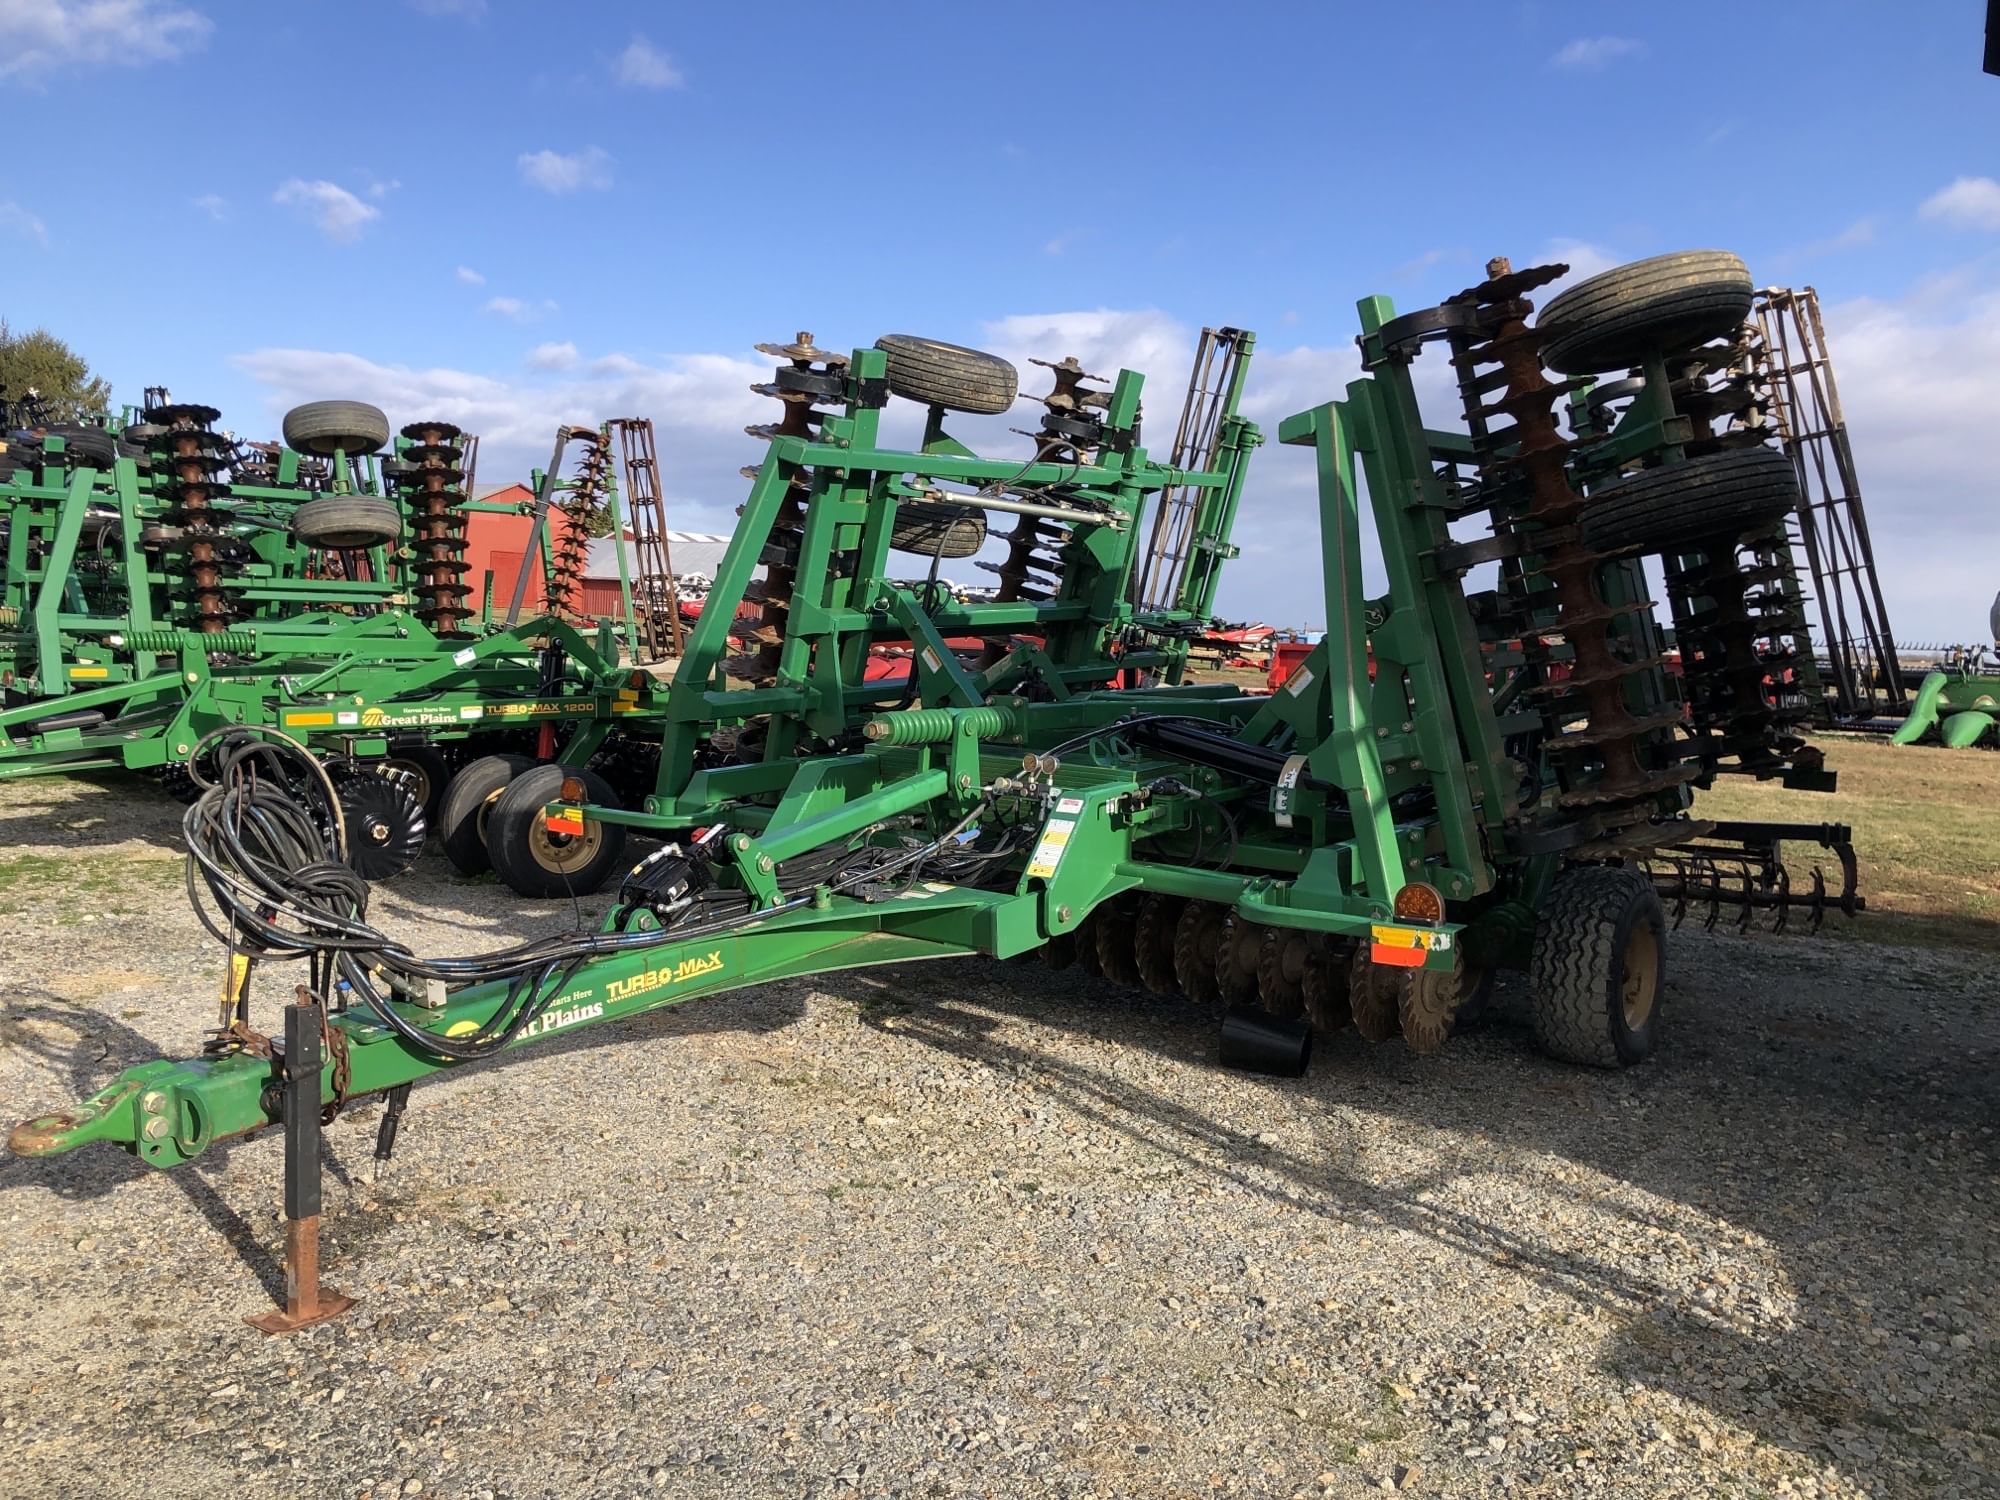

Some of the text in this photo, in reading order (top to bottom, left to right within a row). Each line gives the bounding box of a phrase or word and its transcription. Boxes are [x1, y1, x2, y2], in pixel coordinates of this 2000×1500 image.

[564, 703, 594, 712] 1200
[381, 713, 457, 726] Great Plains
[606, 951, 721, 999] TURBO-MAX
[573, 989, 593, 1001] Here
[541, 1001, 604, 1033] Plains
